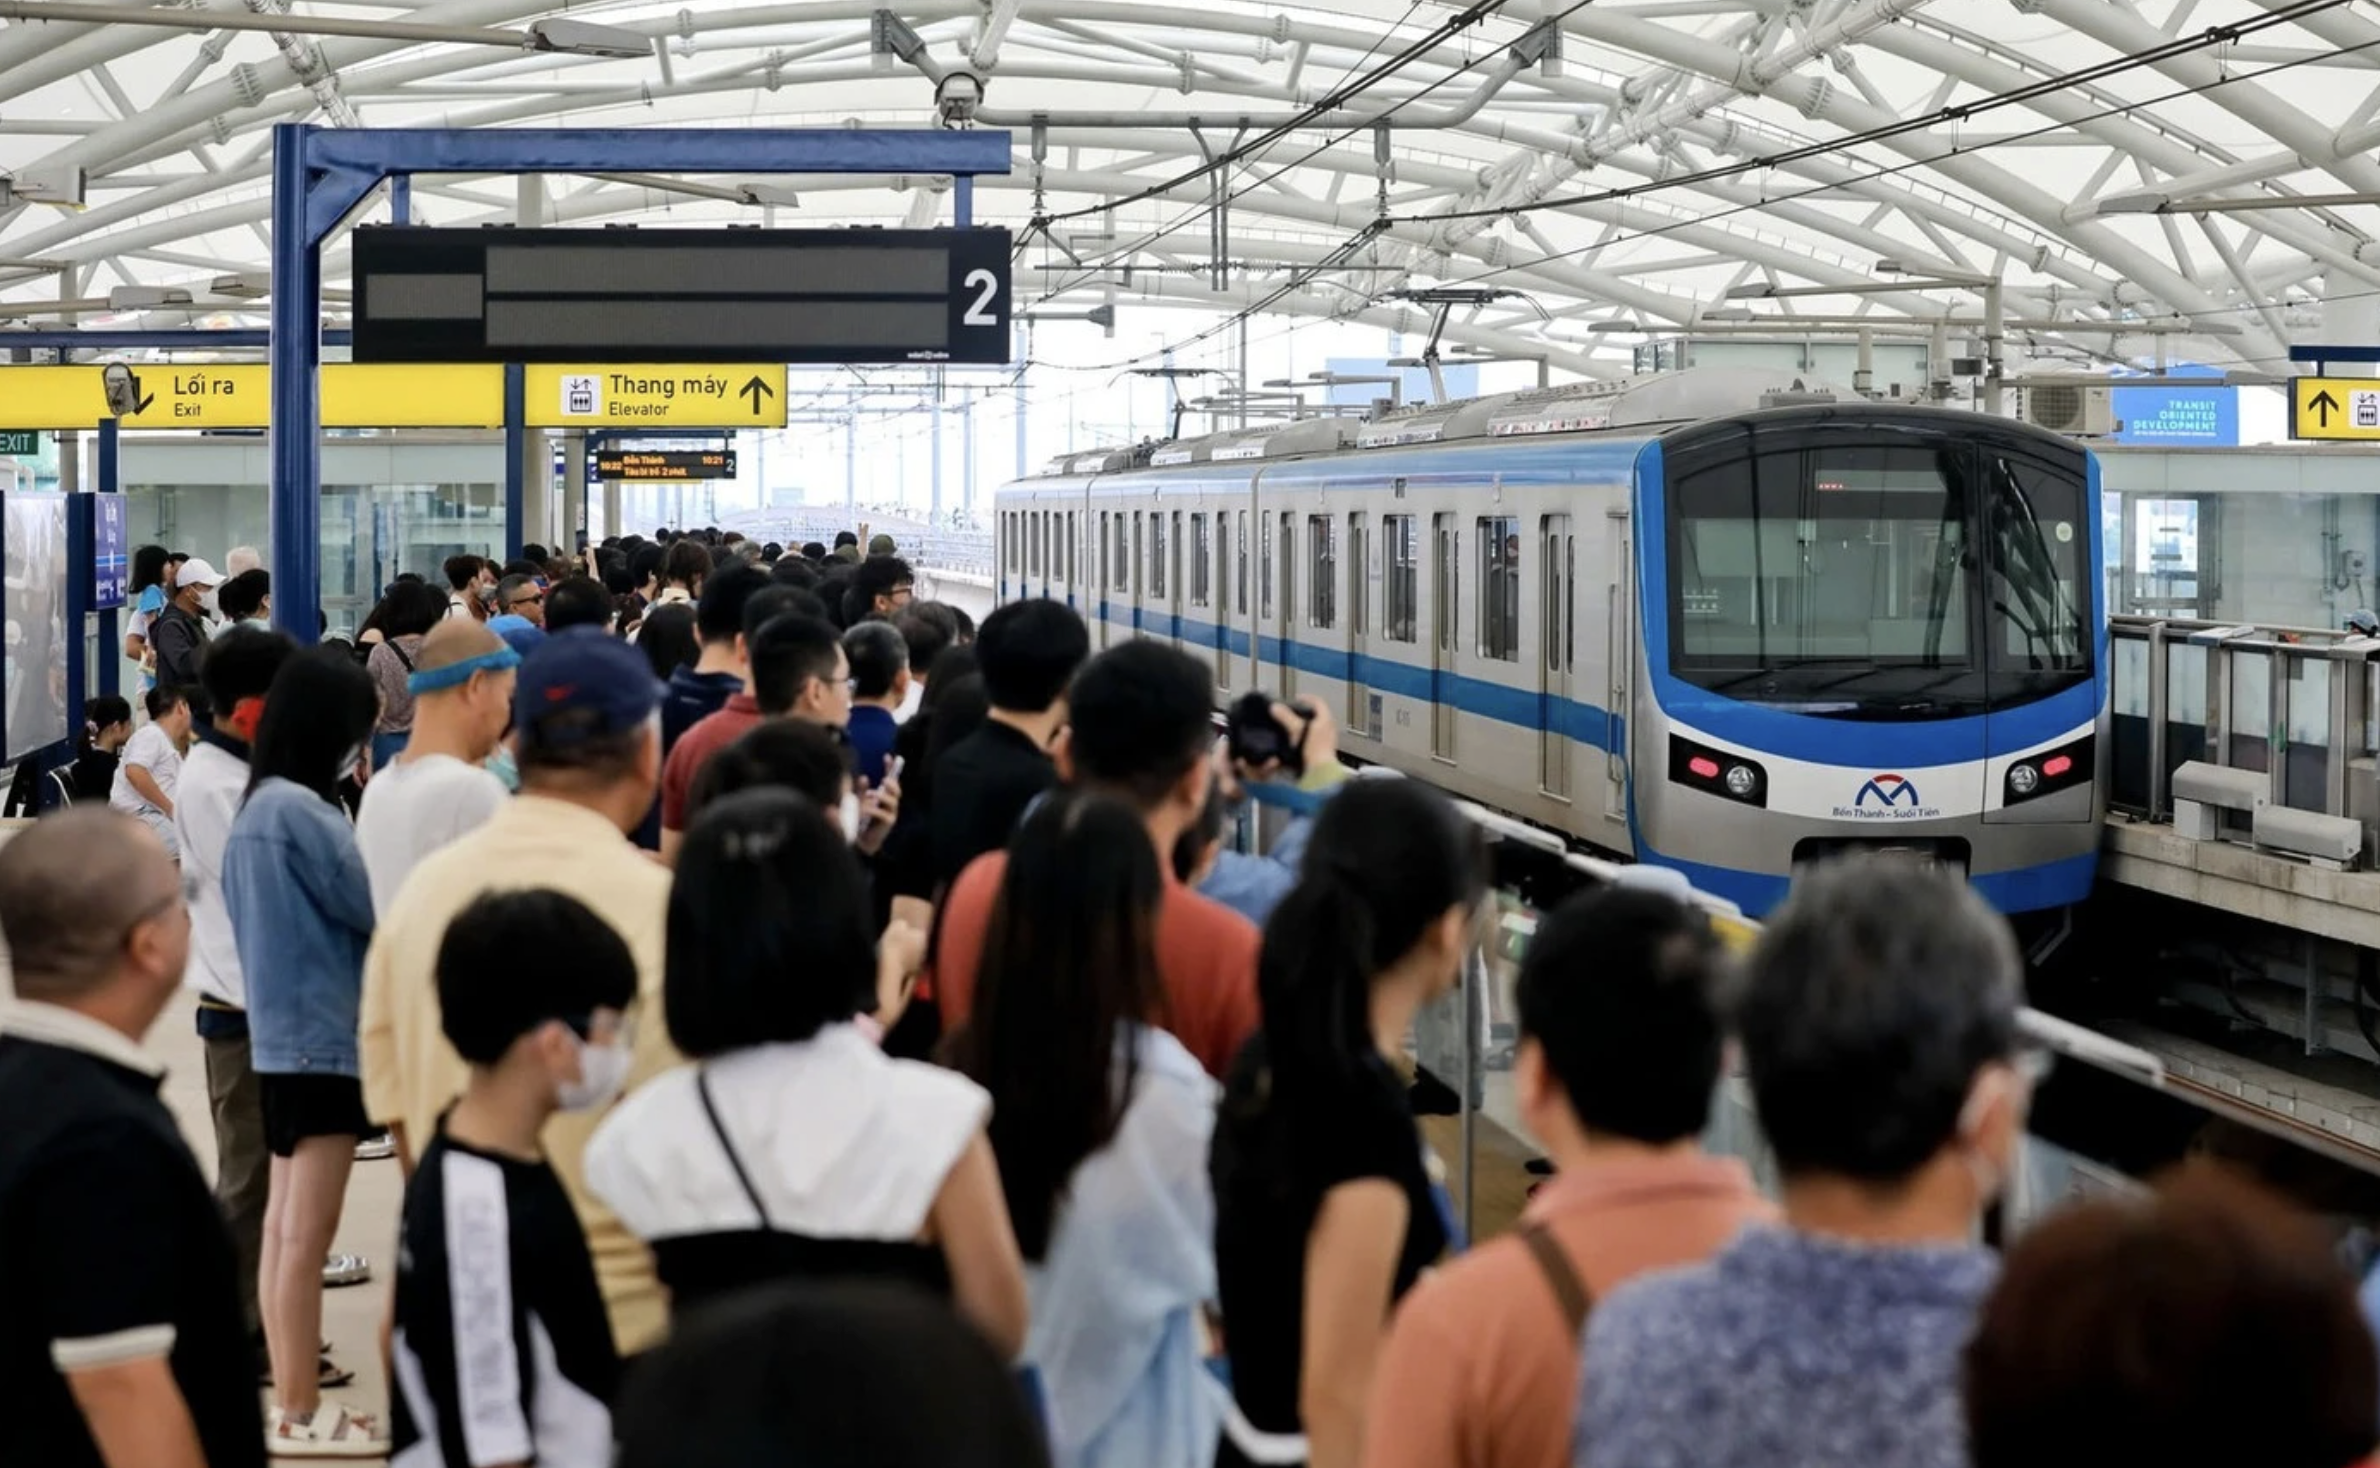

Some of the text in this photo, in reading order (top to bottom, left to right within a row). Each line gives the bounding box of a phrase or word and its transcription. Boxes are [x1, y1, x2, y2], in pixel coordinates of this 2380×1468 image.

[963, 268, 998, 325] 2
[174, 373, 234, 395] Lối ra
[610, 374, 728, 399] Thang máy
[174, 403, 202, 417] Exit
[609, 402, 669, 416] Elevator
[2169, 400, 2216, 410] TRANSIT
[2159, 410, 2216, 420] ORIENTED
[2133, 420, 2216, 431] DEVELOPMENT
[0, 433, 31, 451] EXIT
[726, 459, 735, 472] 2
[1832, 807, 1852, 817] Bến
[1854, 808, 1885, 818] Thành
